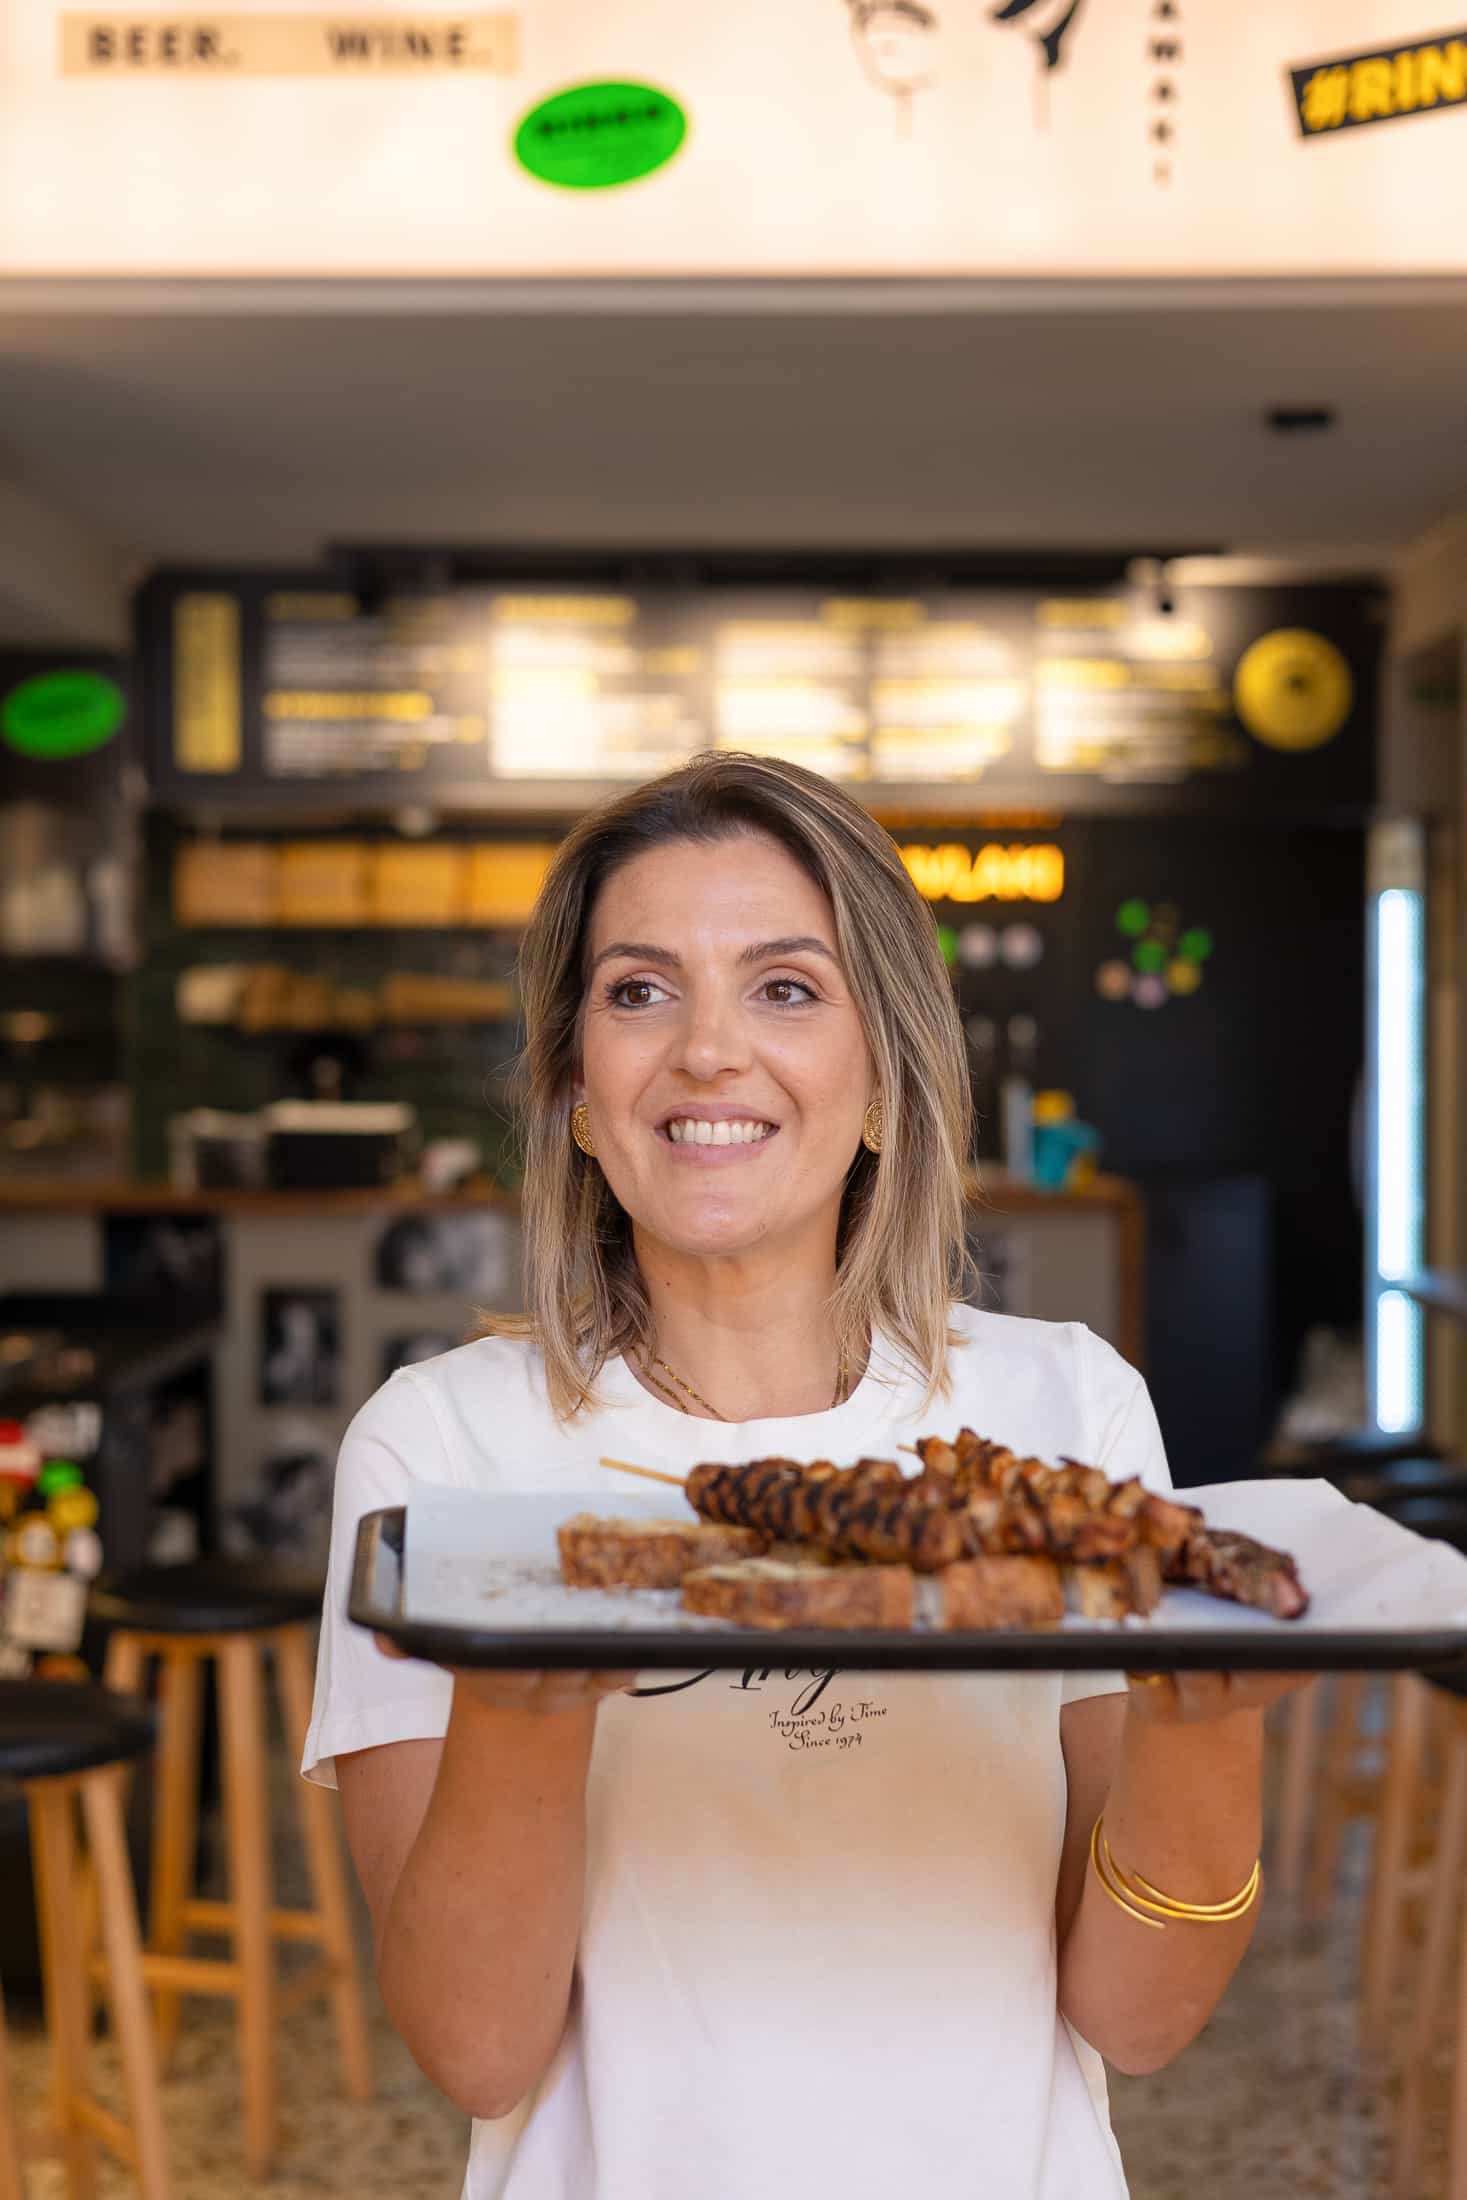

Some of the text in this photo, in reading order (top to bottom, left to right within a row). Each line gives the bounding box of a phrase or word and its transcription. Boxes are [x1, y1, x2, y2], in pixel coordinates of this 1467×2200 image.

[768, 1701, 887, 1737] Inspired by Time
[788, 1729, 862, 1750] Since 1974
